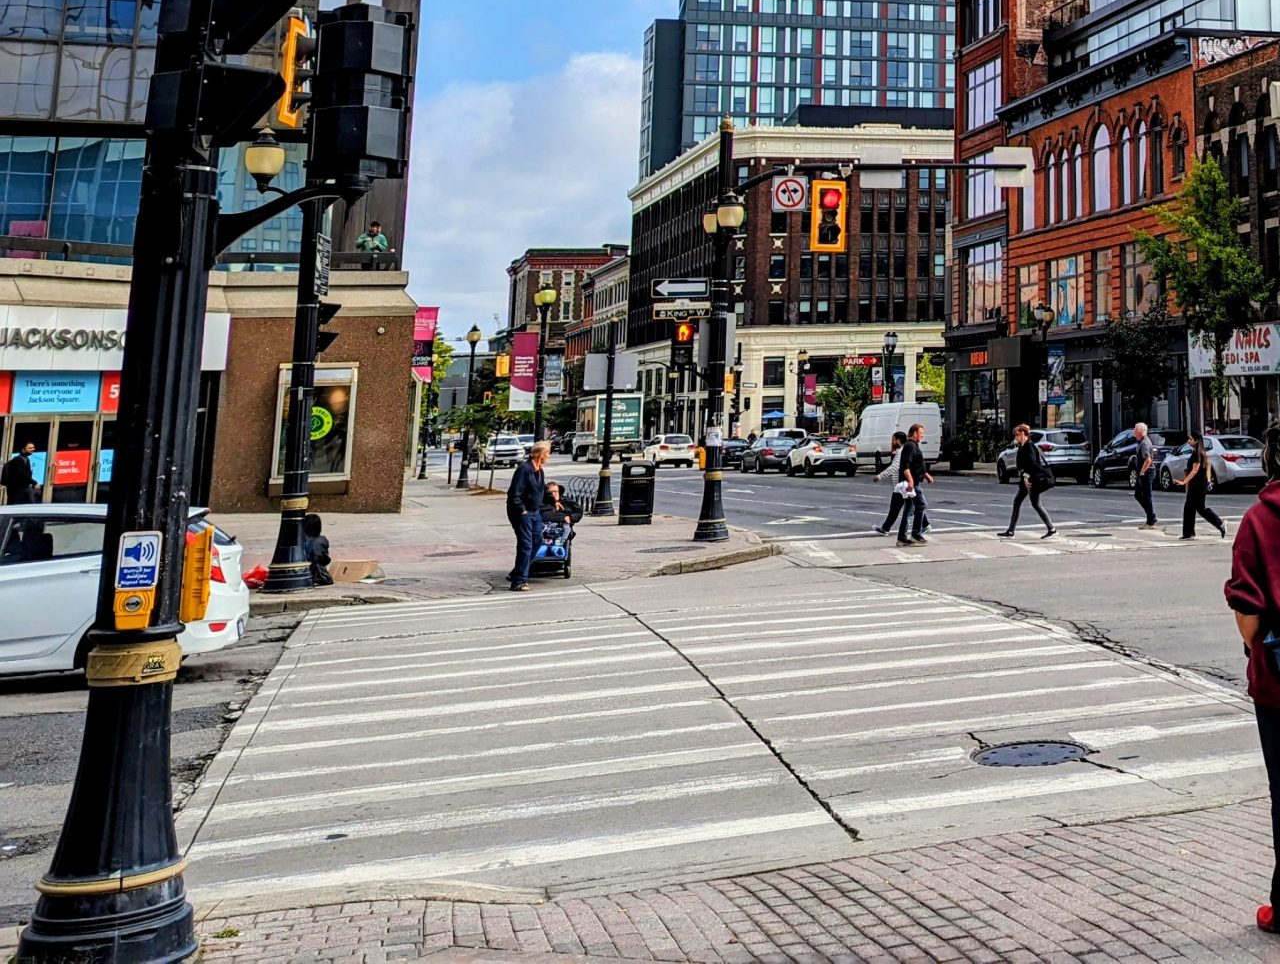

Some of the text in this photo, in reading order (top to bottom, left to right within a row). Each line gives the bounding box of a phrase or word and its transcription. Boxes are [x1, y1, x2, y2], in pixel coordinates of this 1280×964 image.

[1235, 326, 1271, 351] NAILS
[843, 357, 865, 365] PARK
[51, 380, 86, 388] something
[56, 396, 81, 404] Square.
